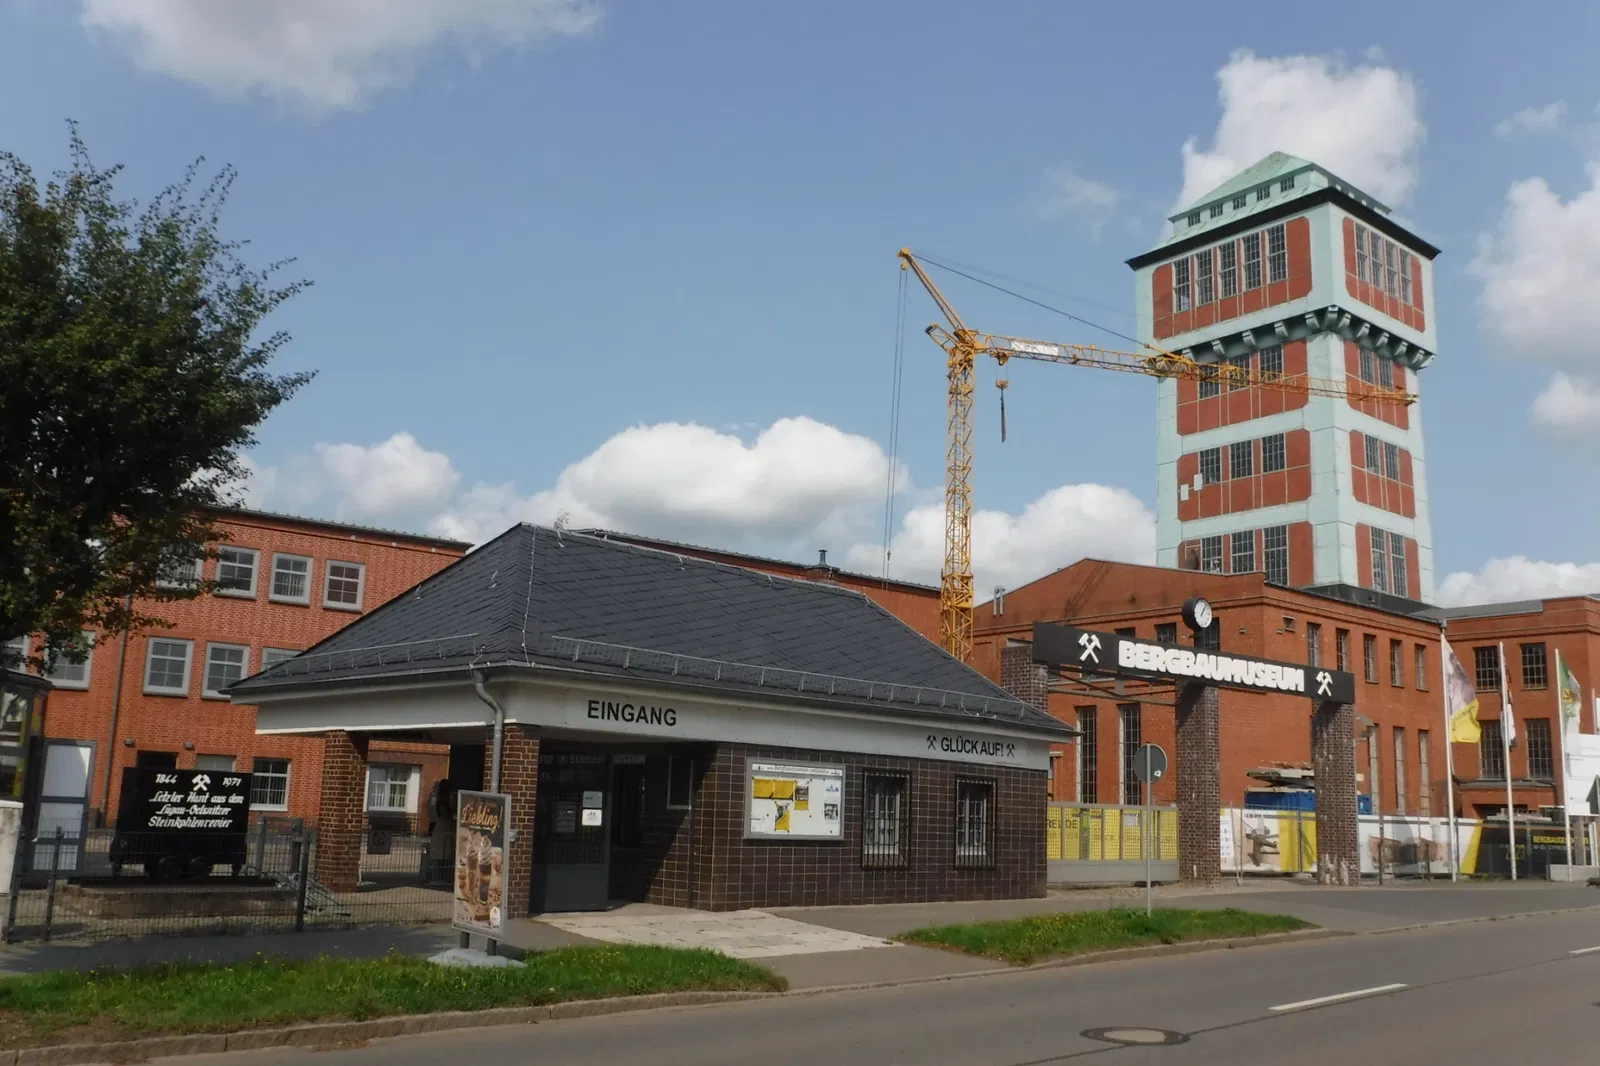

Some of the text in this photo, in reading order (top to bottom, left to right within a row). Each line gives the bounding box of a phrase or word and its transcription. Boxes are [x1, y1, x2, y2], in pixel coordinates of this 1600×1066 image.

[1118, 640, 1305, 692] BERGBAUMUSEUM
[587, 699, 677, 727] EINGANG
[940, 735, 1004, 757] GLÜCK AUF!
[155, 773, 242, 788] 1844 1971
[148, 791, 245, 805] Letzter Hunt aus dem
[155, 804, 232, 817] Lugau-Oelsnitzer
[147, 815, 233, 829] Steinkohlenrevier
